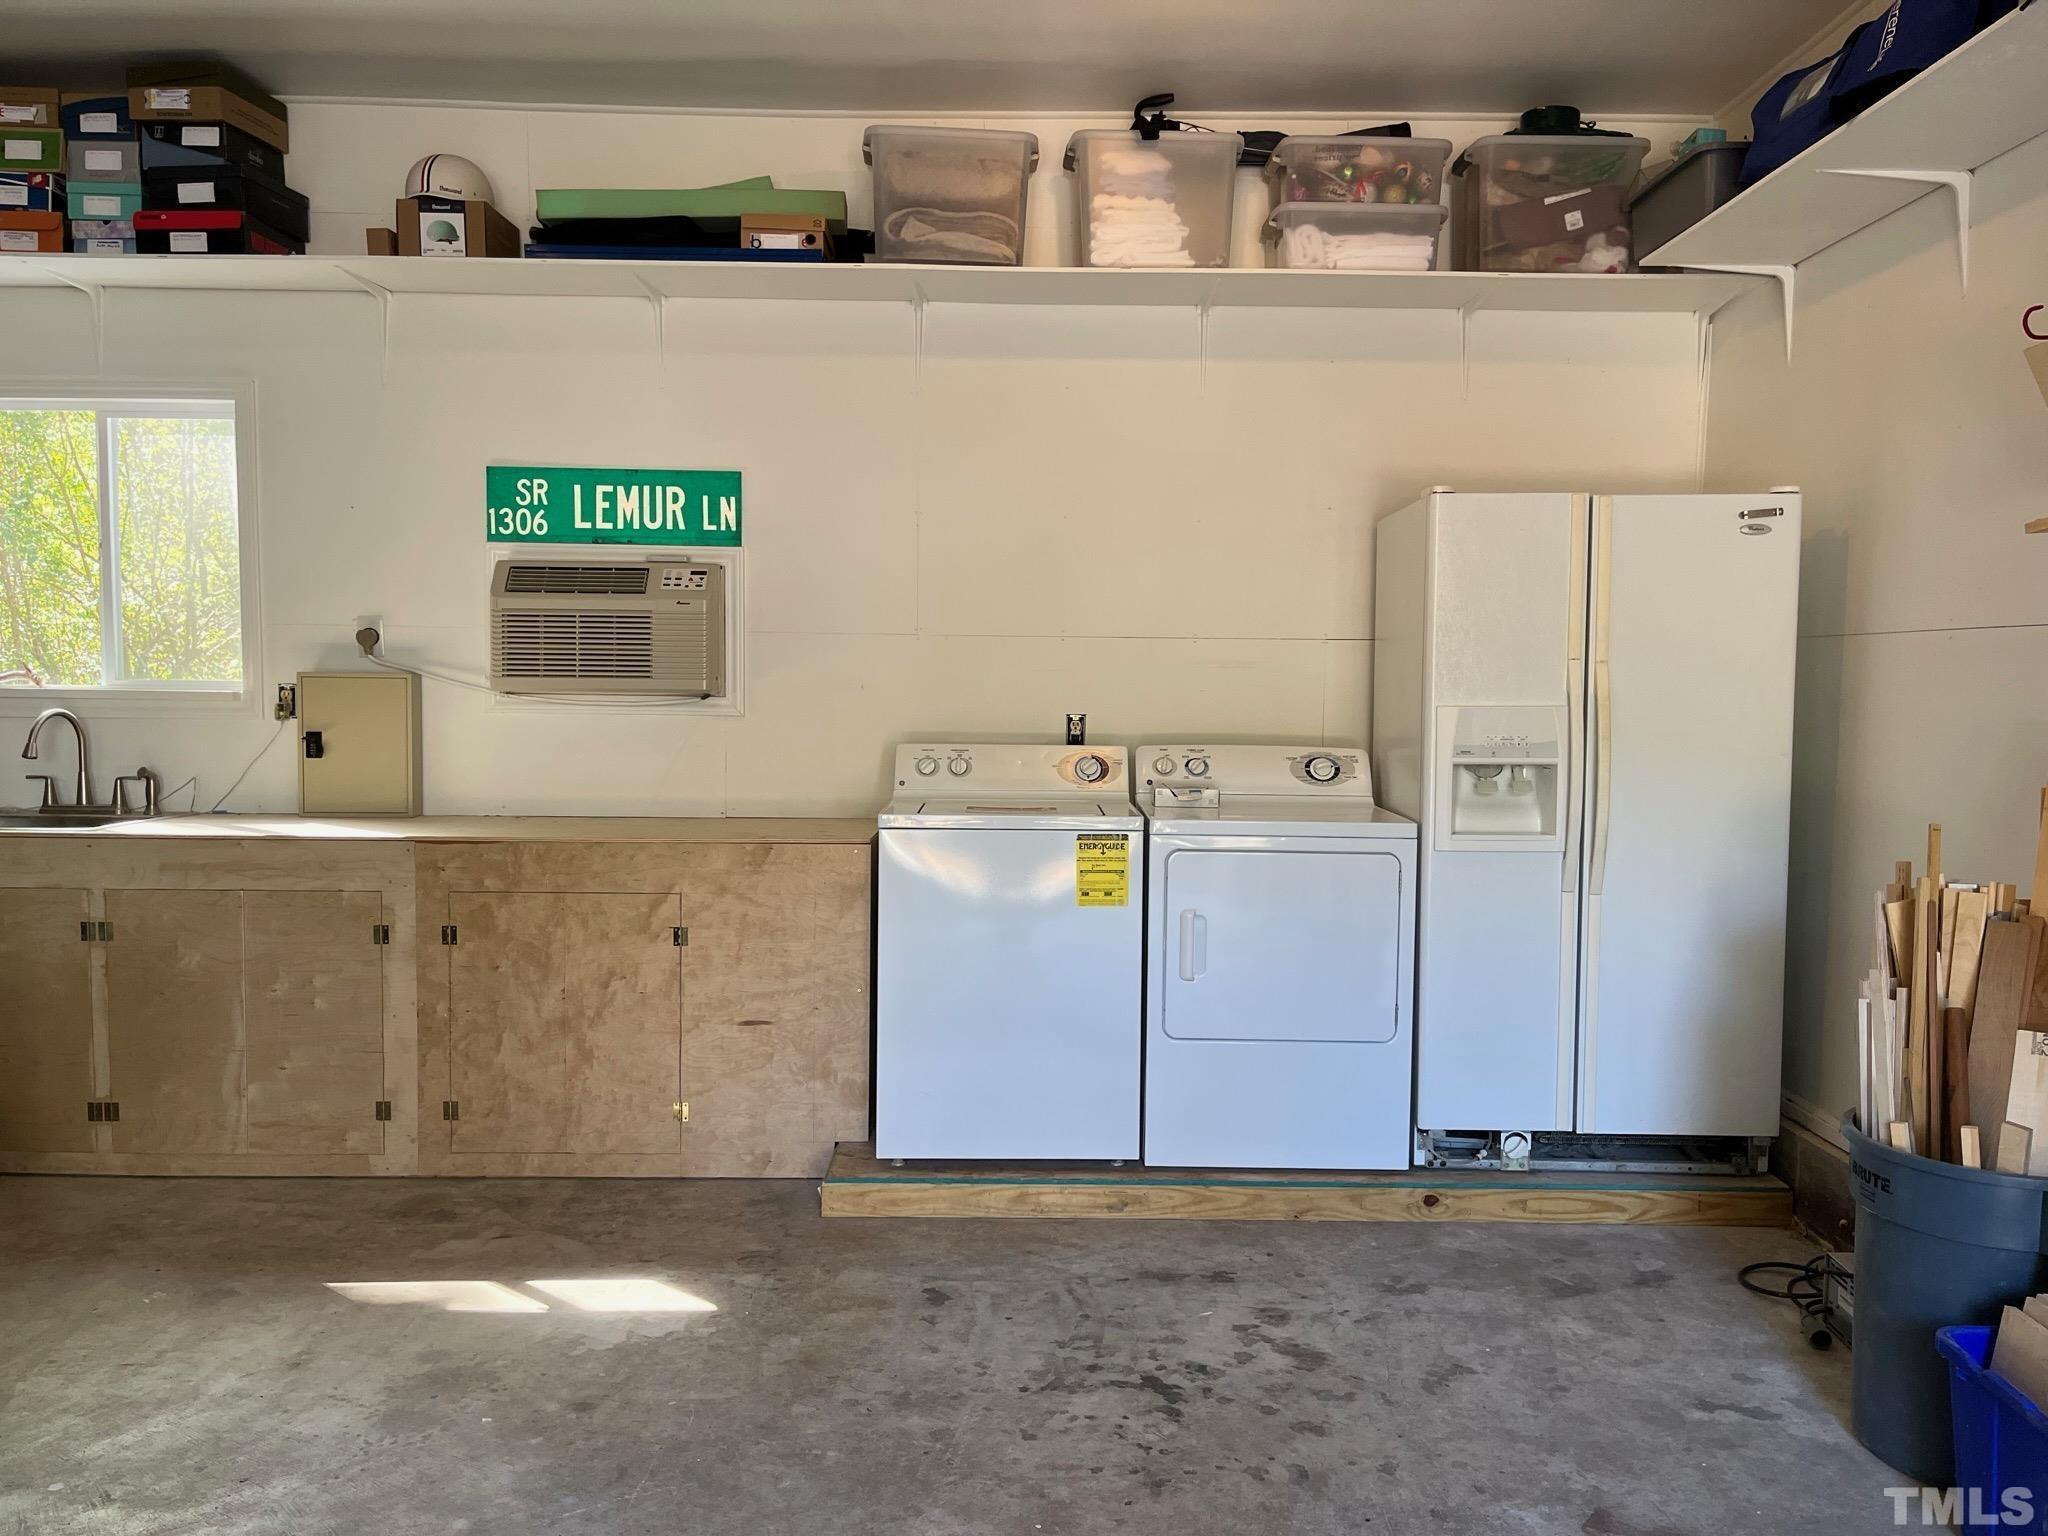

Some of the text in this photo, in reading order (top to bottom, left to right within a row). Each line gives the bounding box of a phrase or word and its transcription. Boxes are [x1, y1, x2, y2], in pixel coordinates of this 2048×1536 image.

[515, 478, 549, 506] SR
[488, 507, 549, 535] 1306
[573, 484, 737, 532] LEMUR LN
[1852, 1160, 1894, 1195] BRUTE
